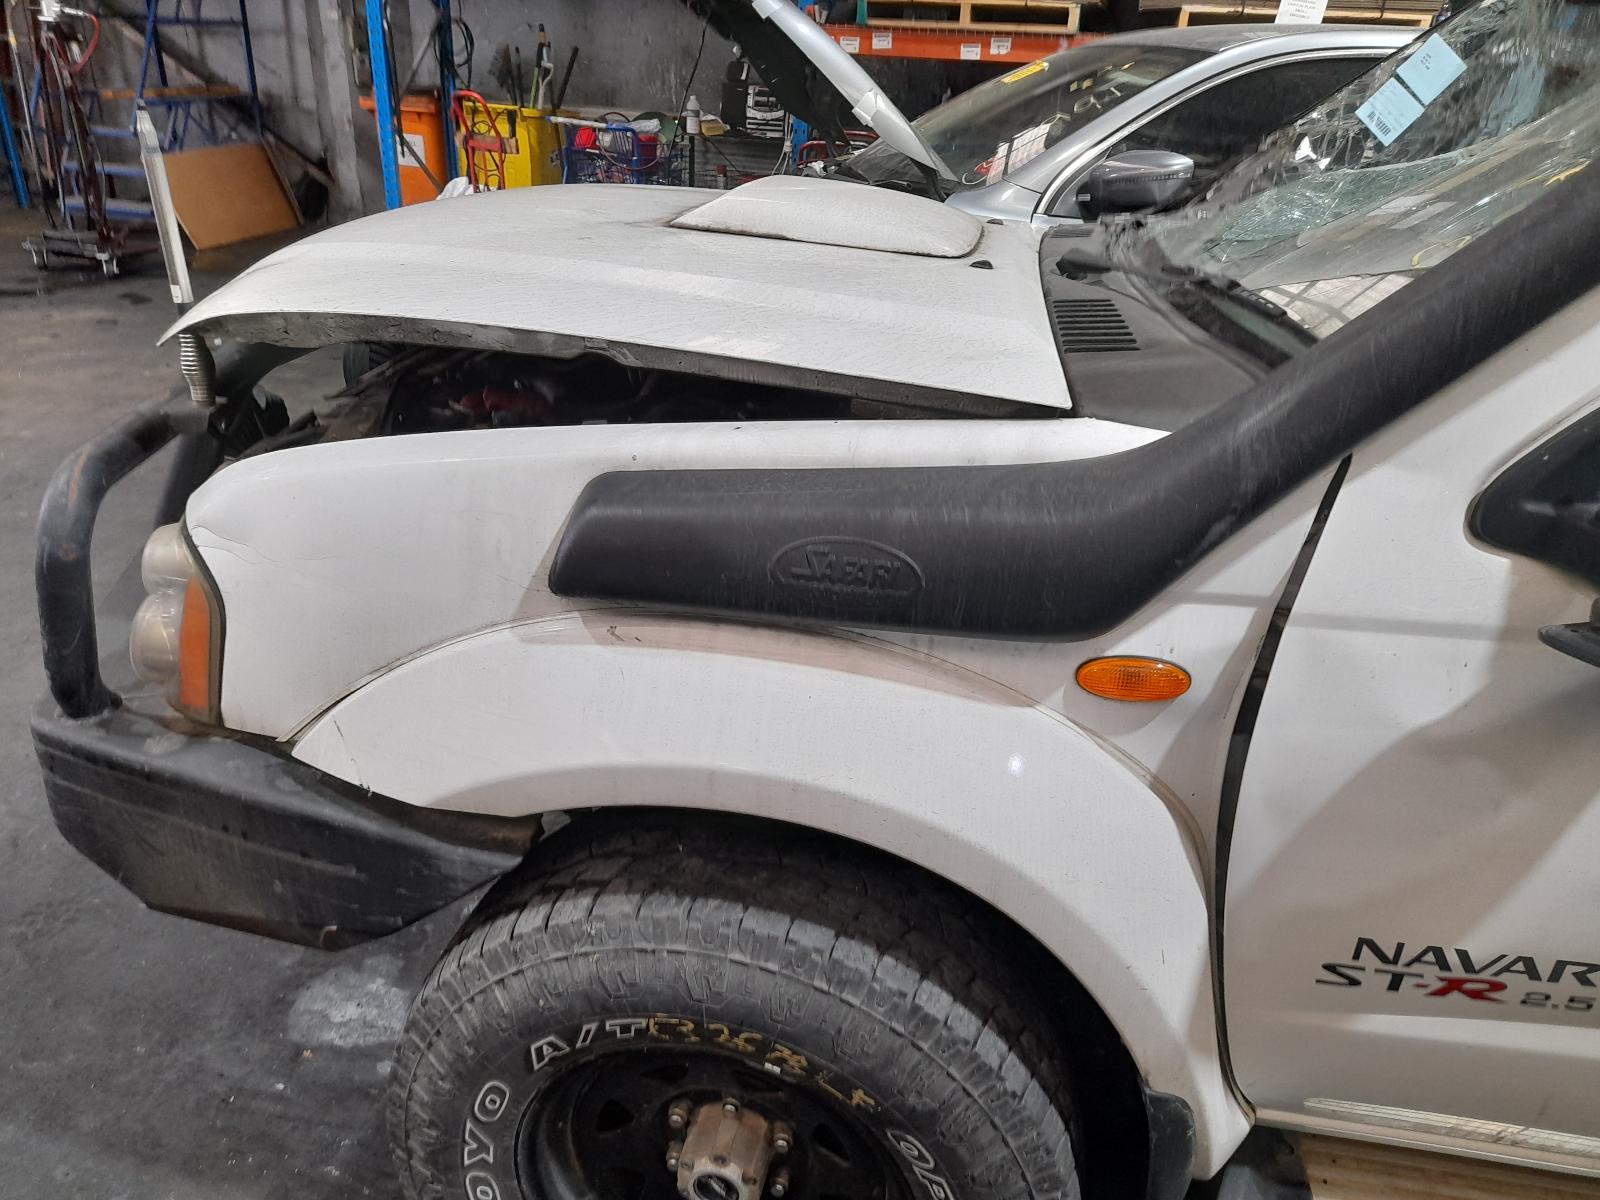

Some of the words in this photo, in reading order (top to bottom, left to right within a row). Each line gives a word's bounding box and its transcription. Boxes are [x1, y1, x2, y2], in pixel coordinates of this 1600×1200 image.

[1315, 962, 1509, 1004] ST-R
[1520, 991, 1597, 1010] 2.5
[1352, 937, 1600, 987] NAVAR
[530, 1017, 648, 1071] A/T
